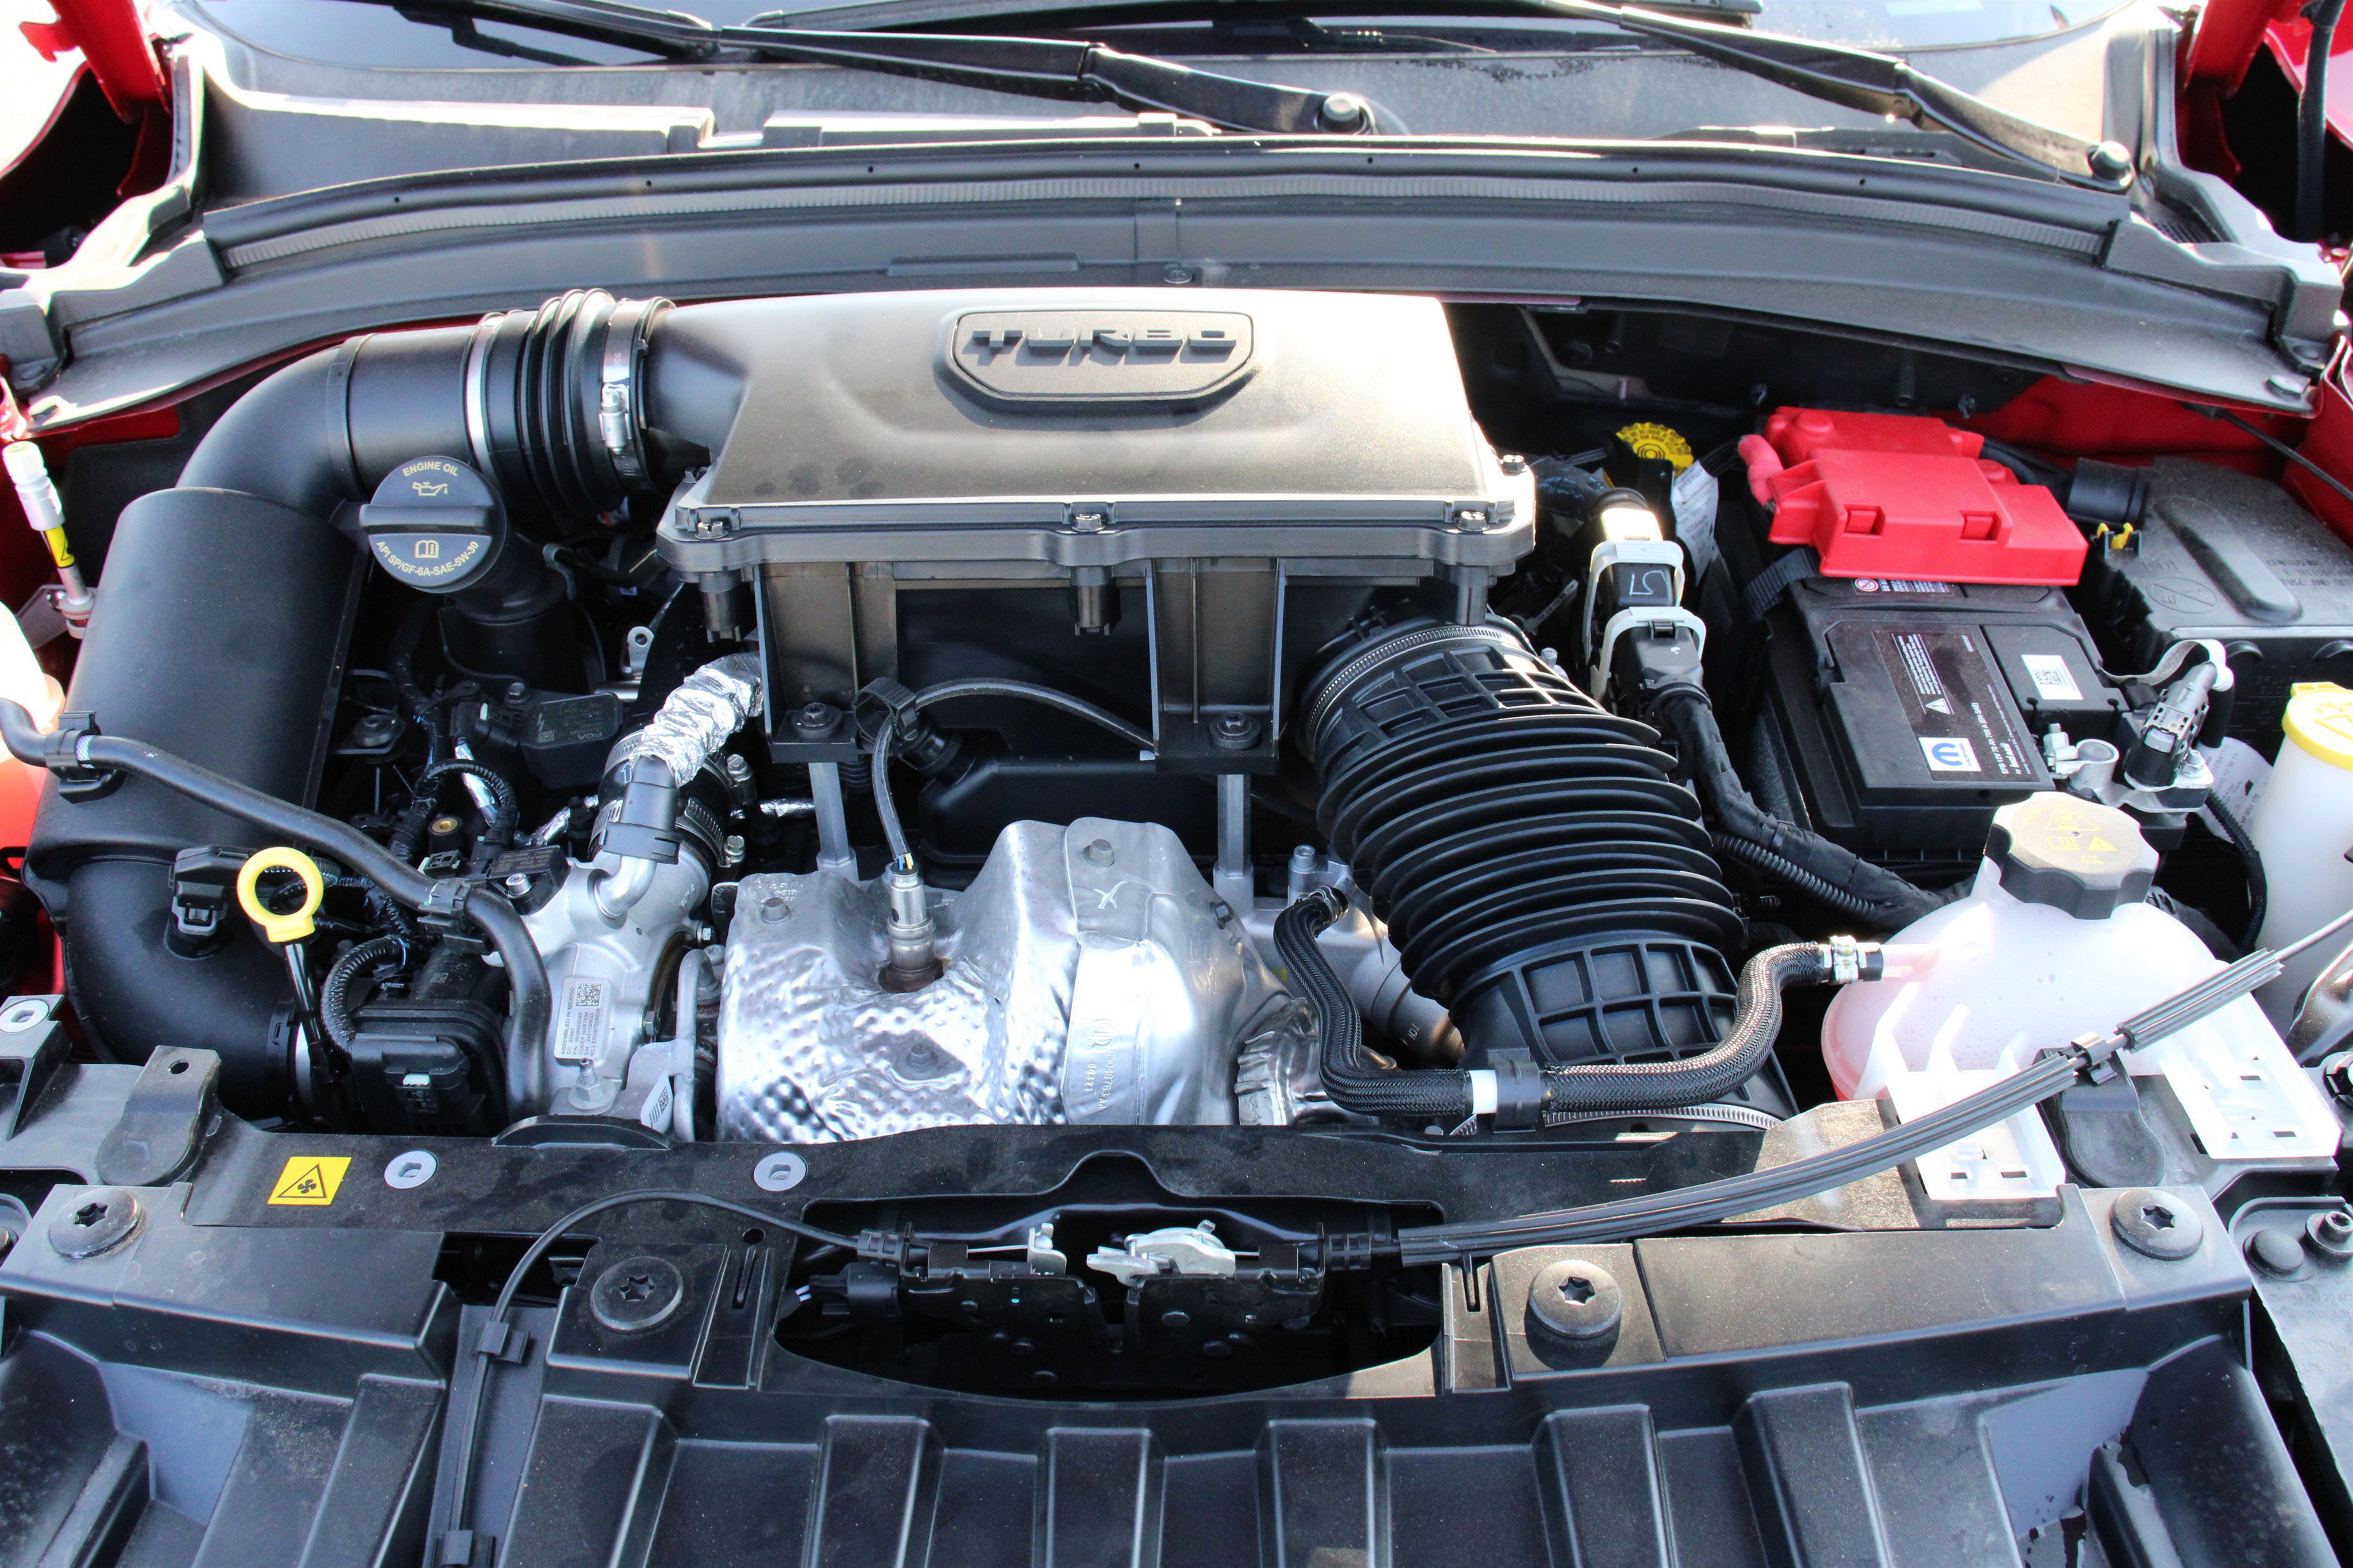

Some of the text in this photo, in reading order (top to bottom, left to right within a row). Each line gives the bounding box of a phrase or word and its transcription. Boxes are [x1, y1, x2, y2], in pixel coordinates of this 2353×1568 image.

[973, 329, 1237, 349] TURBO
[402, 461, 458, 477] ENGINE OIL
[376, 540, 392, 558] API
[1958, 743, 1973, 767] MOPAR
[561, 1018, 570, 1055] ASSEMBLED
